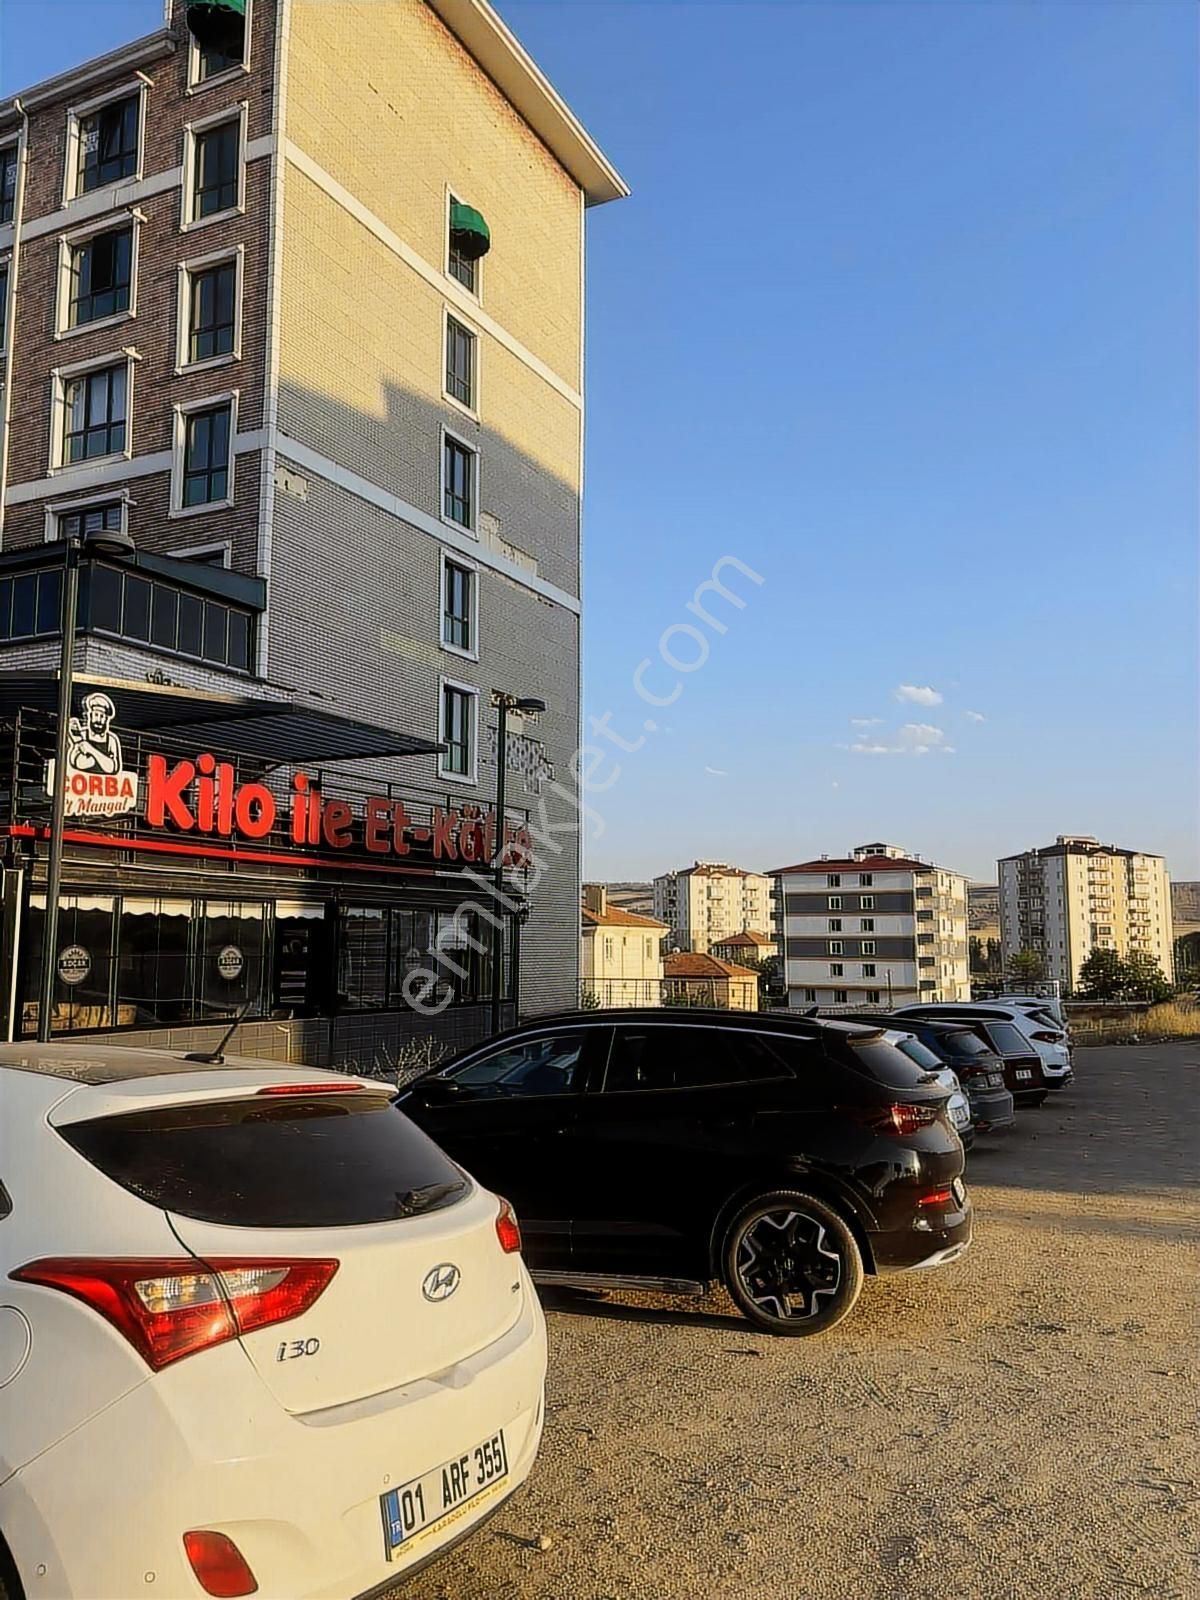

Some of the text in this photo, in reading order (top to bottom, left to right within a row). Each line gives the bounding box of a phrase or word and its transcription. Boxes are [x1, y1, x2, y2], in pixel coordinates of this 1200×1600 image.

[77, 797, 129, 815] Mangal
[147, 754, 275, 838] Kilo
[276, 1338, 320, 1362] i30
[401, 1436, 503, 1532] 01 ARF 355
